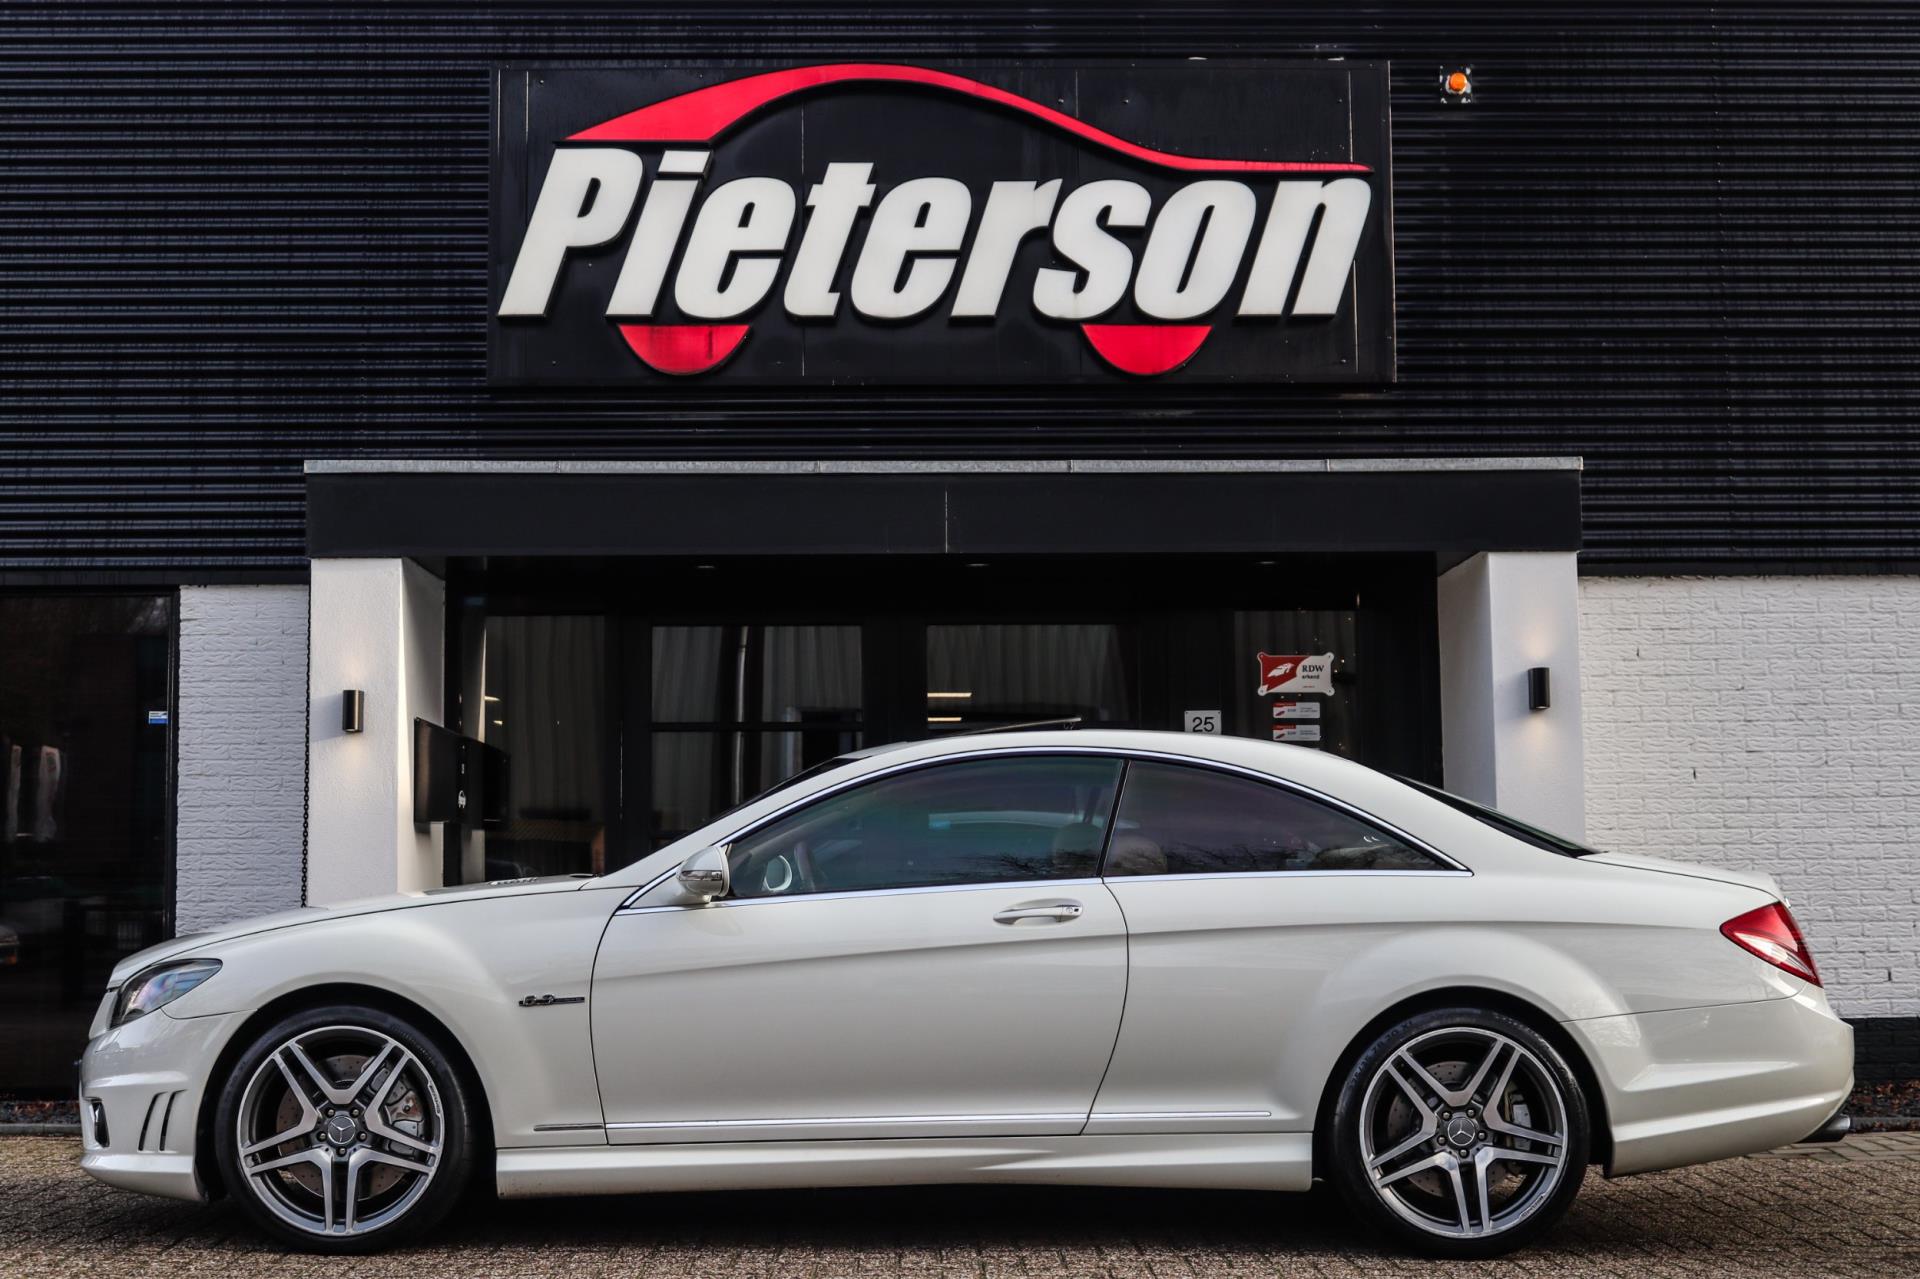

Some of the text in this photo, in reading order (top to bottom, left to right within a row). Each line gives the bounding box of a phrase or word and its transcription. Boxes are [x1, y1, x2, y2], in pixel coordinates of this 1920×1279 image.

[497, 147, 1373, 321] Pieterson
[1302, 664, 1324, 673] RDW
[1192, 716, 1215, 733] 25
